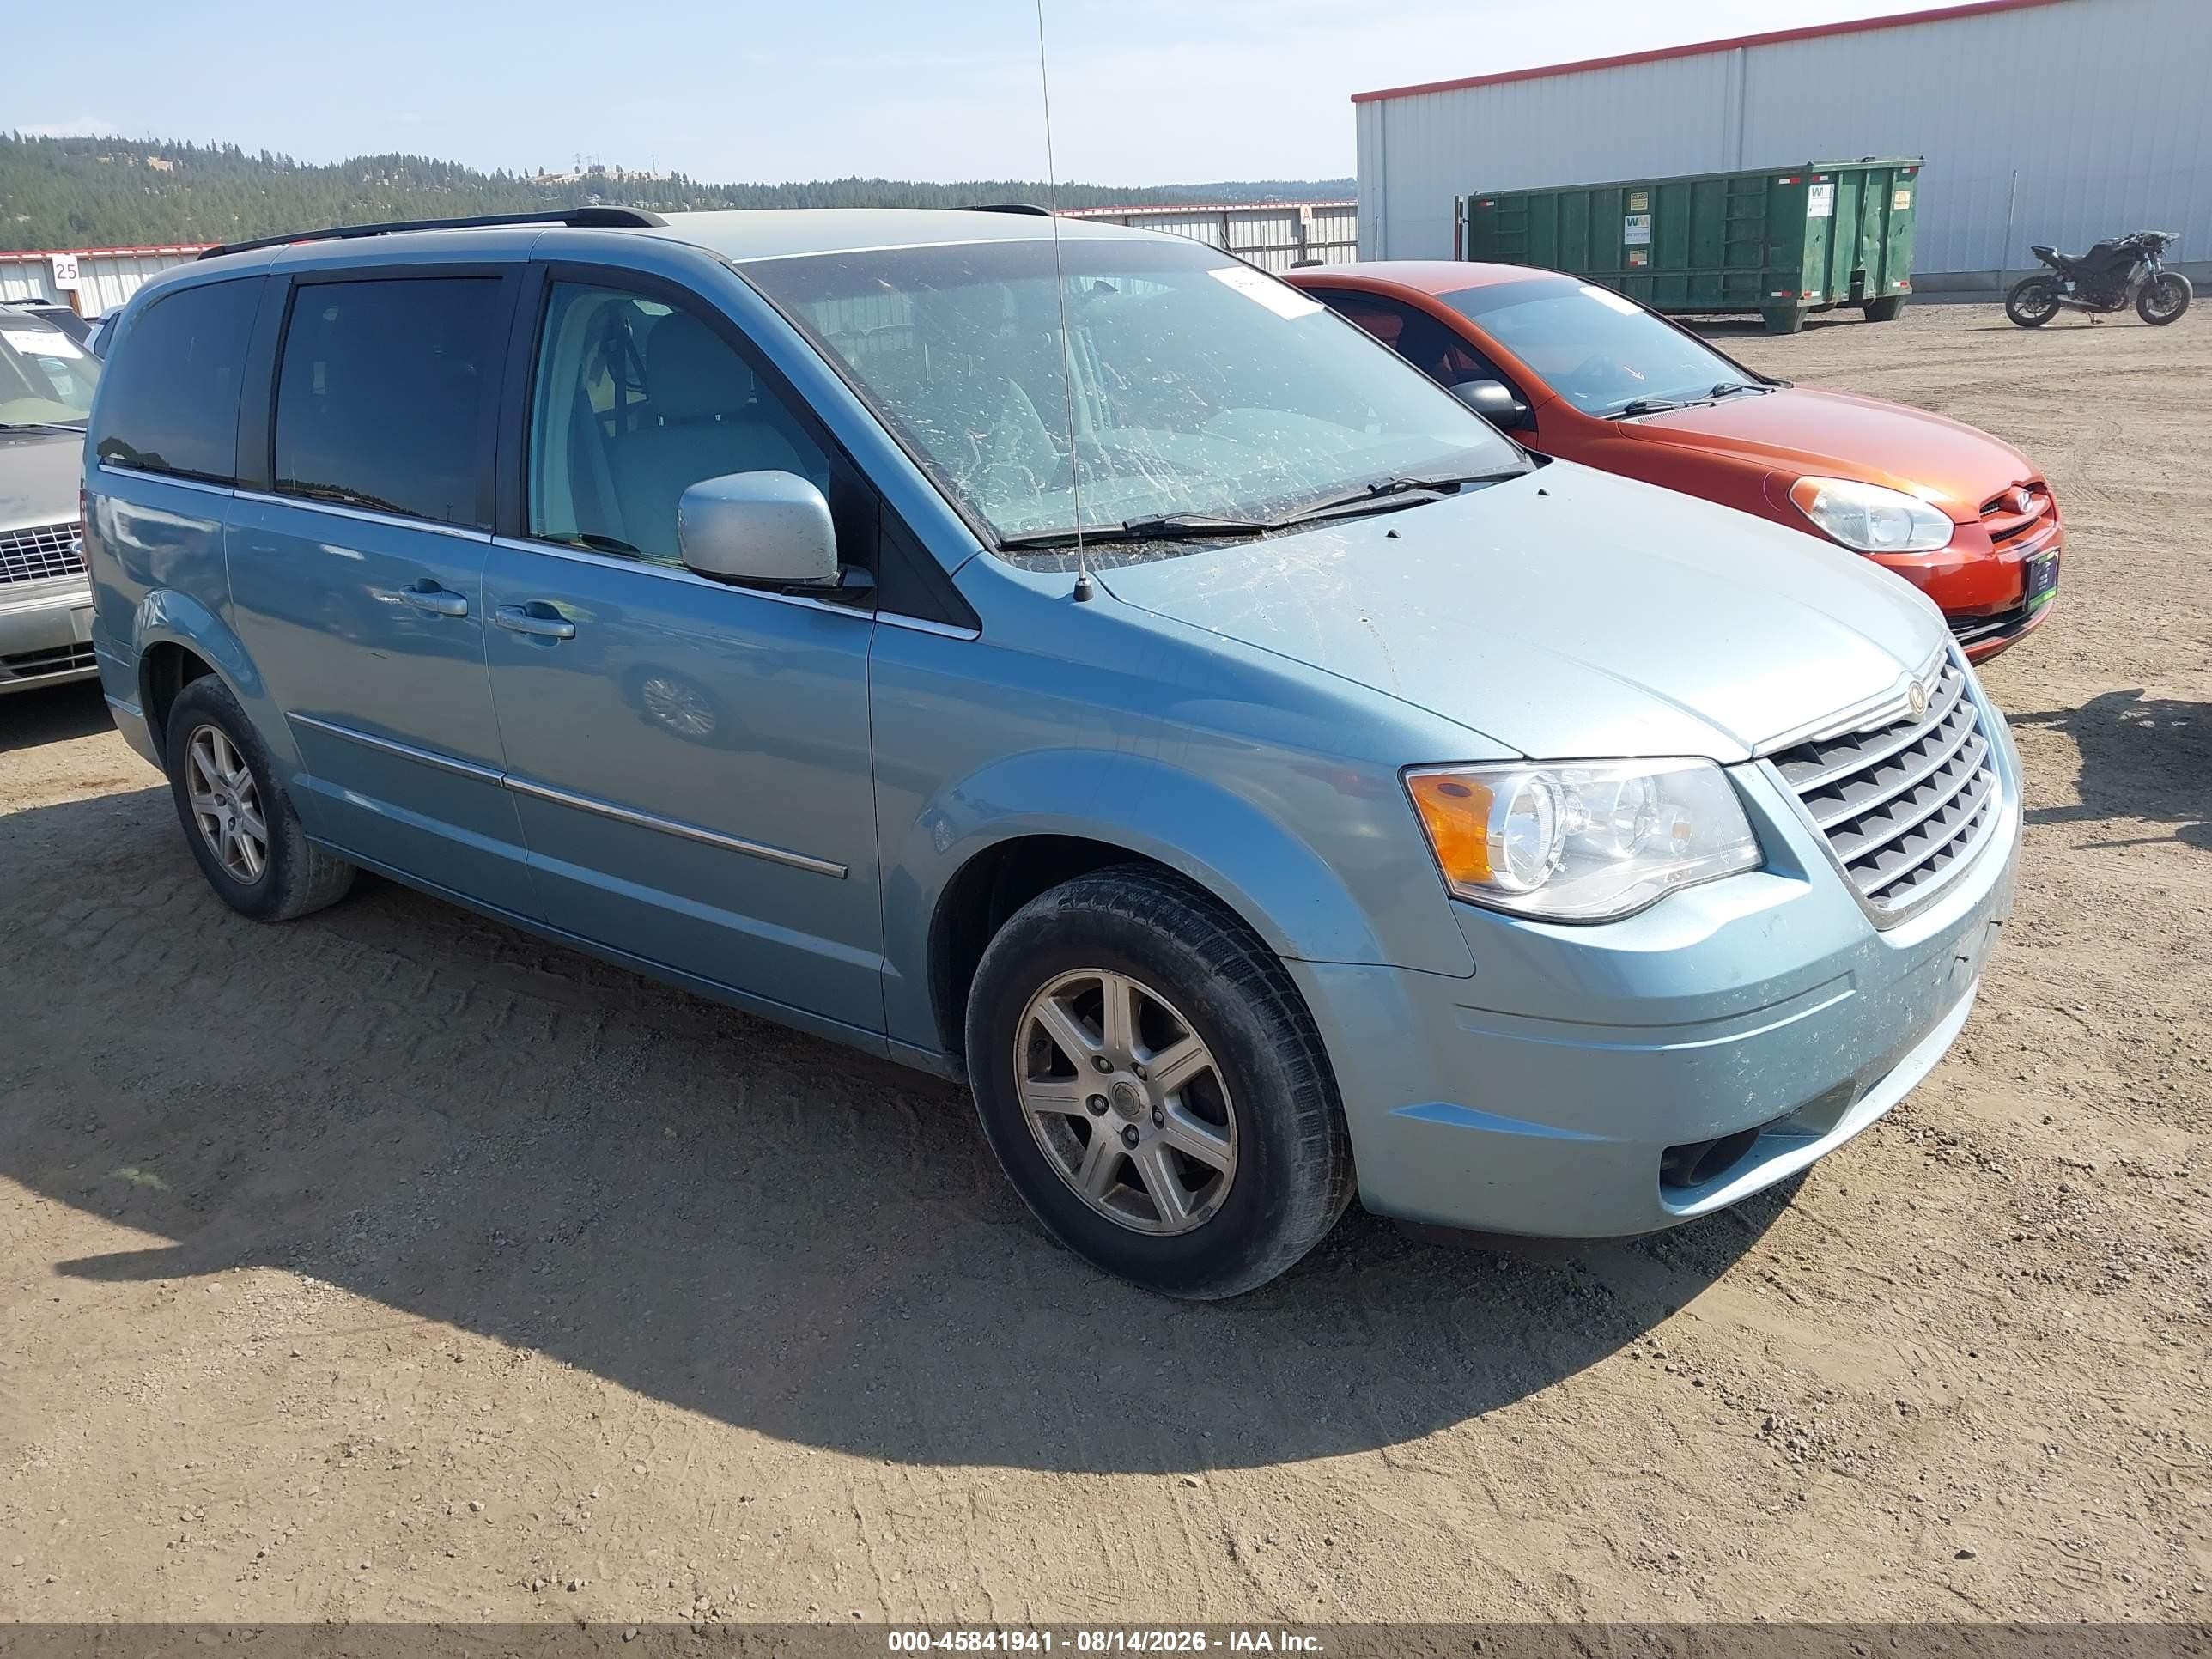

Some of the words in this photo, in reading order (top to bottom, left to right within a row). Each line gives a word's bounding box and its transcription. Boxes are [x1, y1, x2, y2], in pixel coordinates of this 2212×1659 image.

[1304, 207, 1311, 223] A
[1626, 216, 1650, 227] WM
[56, 263, 76, 280] 25
